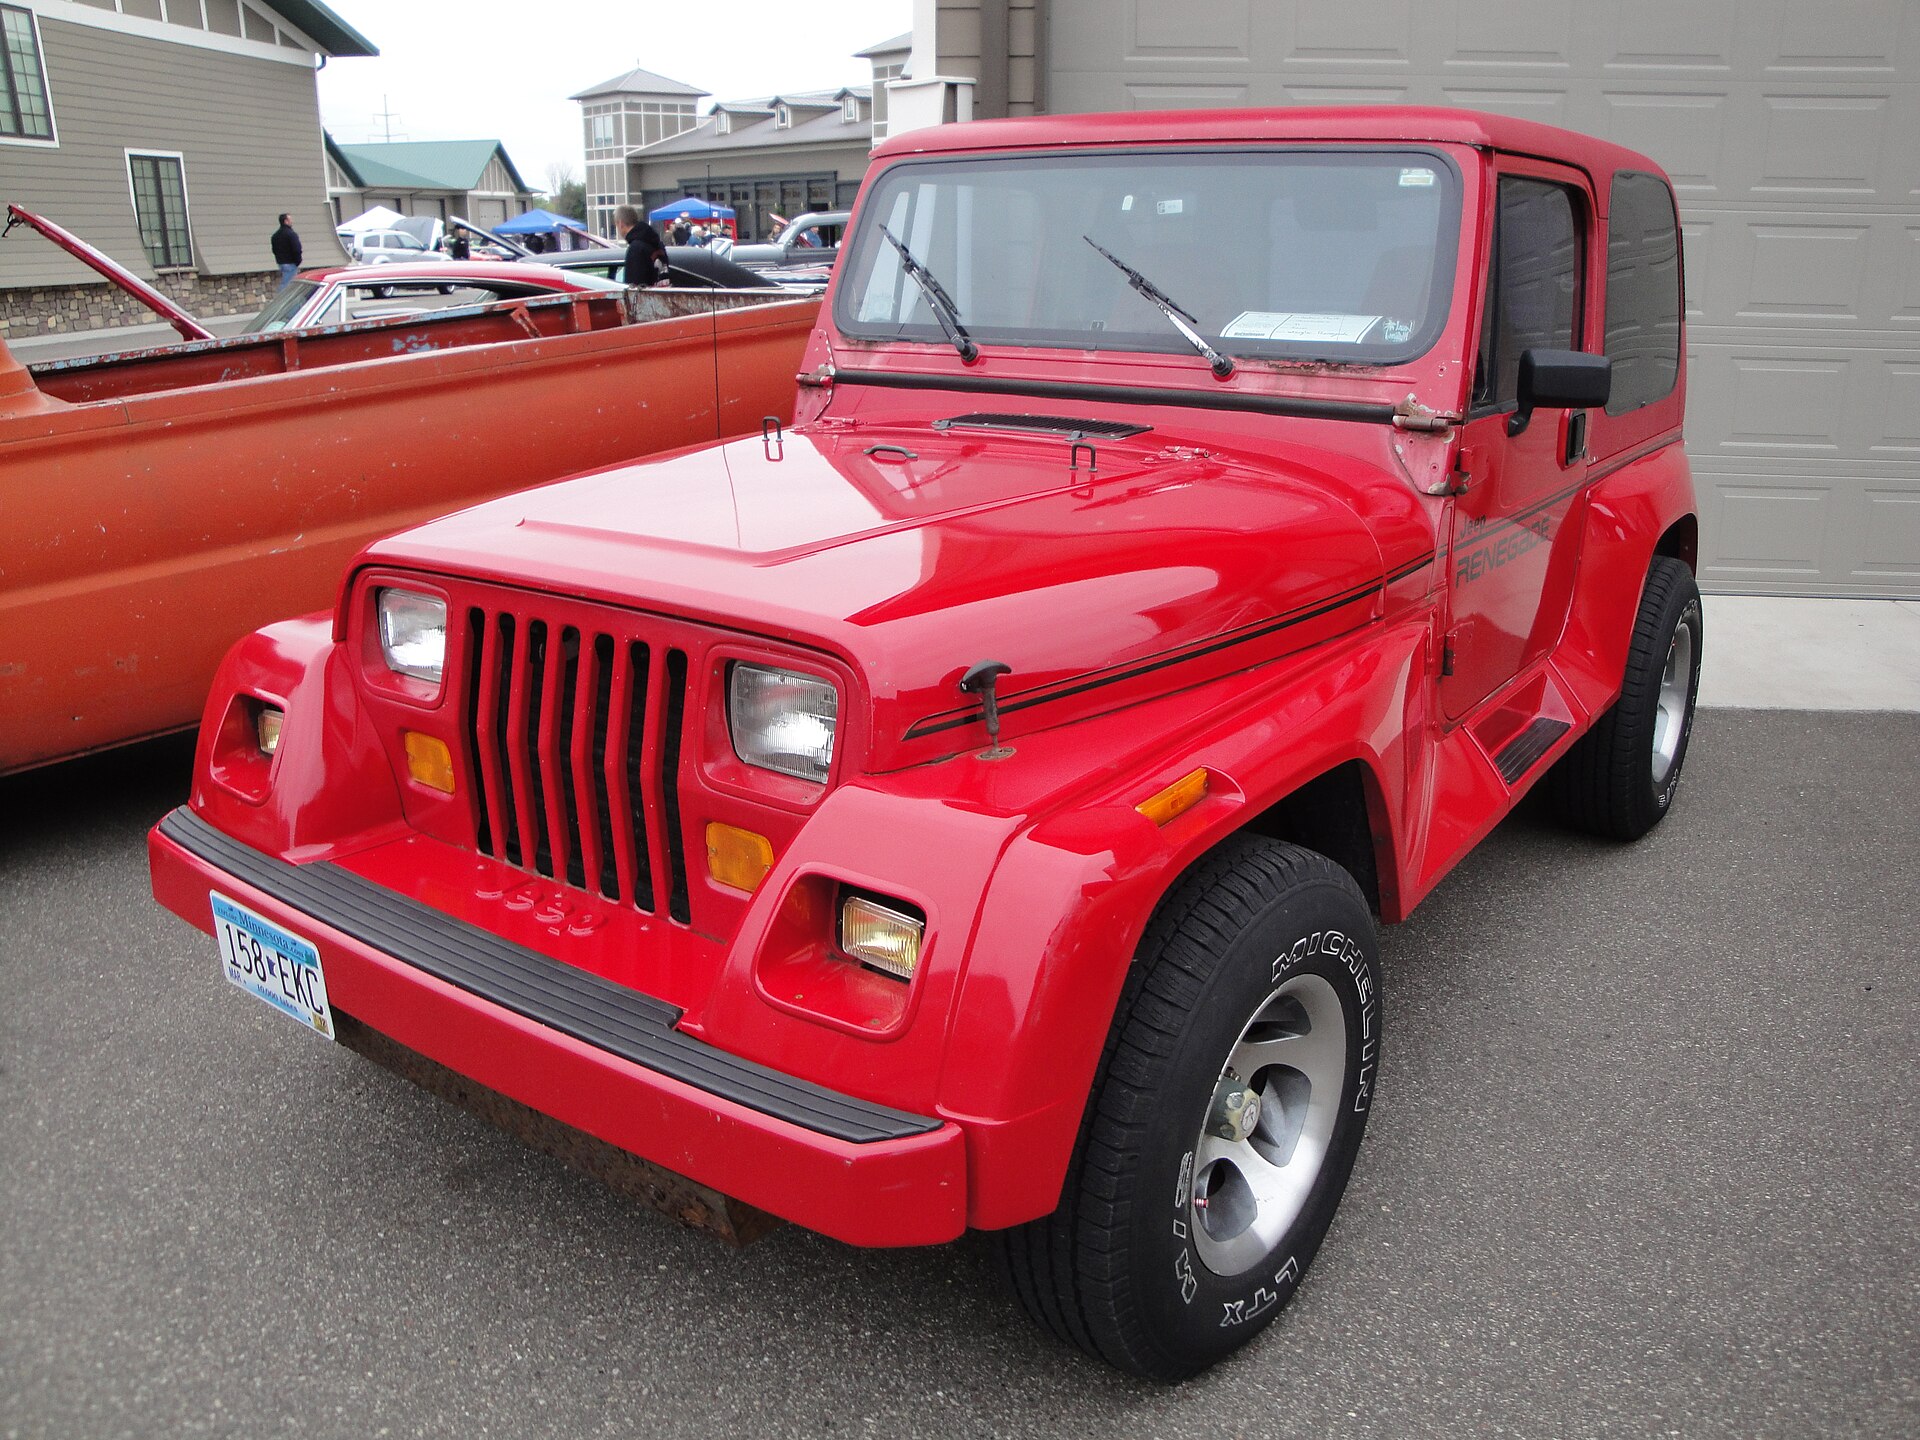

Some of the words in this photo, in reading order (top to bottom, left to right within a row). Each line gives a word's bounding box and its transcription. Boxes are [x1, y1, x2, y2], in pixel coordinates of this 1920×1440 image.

[1455, 515, 1551, 588] RENEGADE
[1459, 514, 1487, 540] Jeep
[225, 923, 267, 982] 158
[276, 950, 324, 1015] EKC
[1271, 930, 1376, 1113] MICHELIN
[1219, 1256, 1299, 1328] LTX
